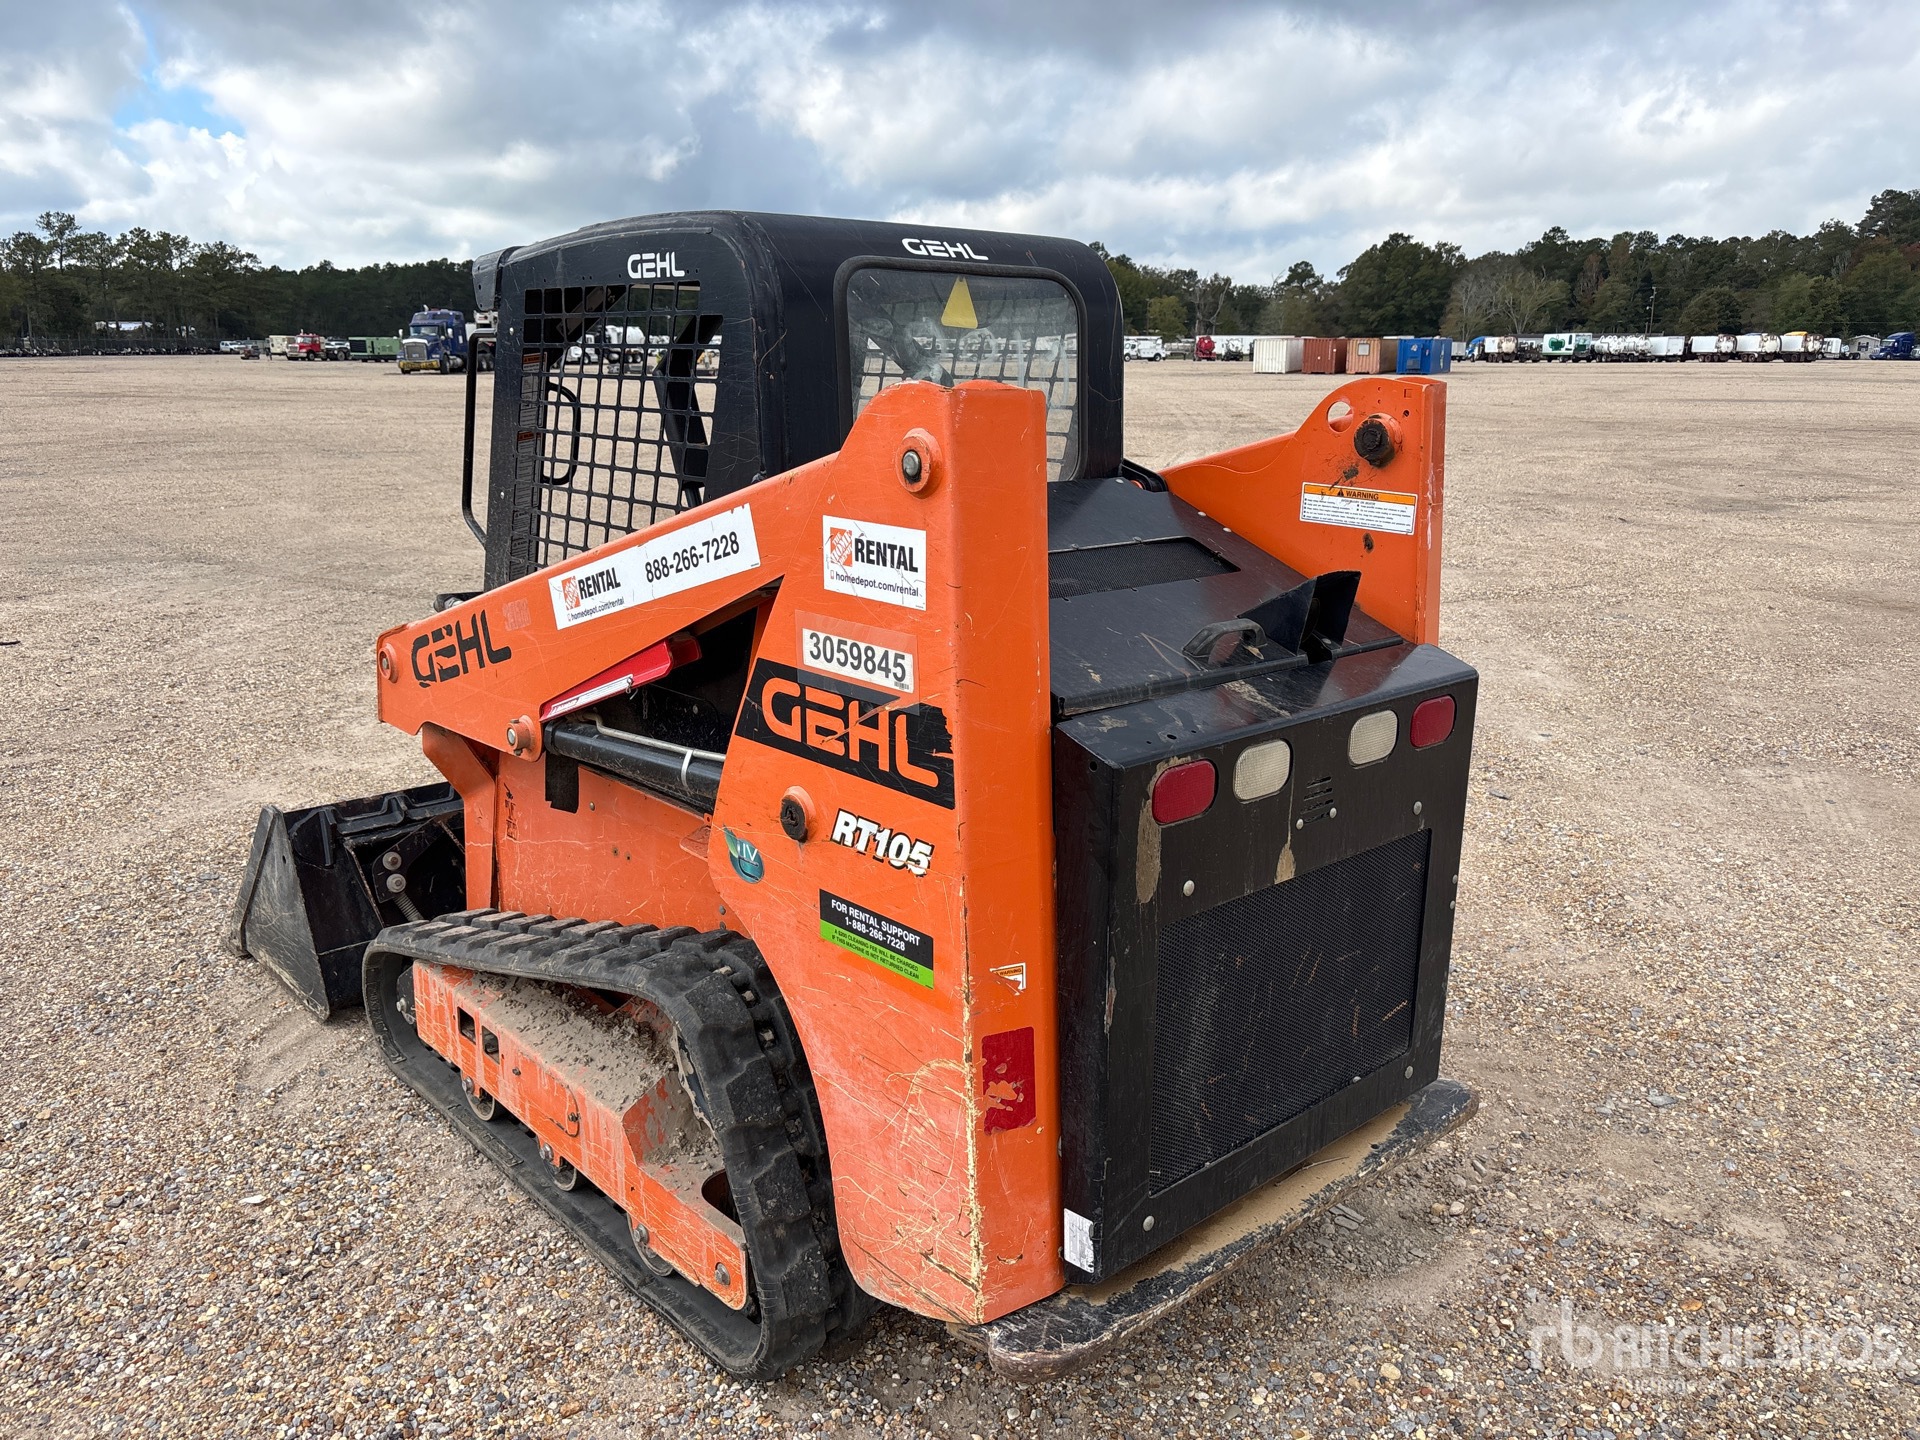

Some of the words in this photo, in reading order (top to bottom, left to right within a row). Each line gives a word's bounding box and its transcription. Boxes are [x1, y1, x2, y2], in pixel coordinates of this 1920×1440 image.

[627, 251, 685, 279] GEHL
[902, 238, 989, 260] GEHL
[1346, 490, 1379, 501] WARNING
[645, 531, 740, 583] 888-266-7228
[855, 538, 918, 573] RENTAL
[578, 567, 621, 600] RENTAL
[835, 571, 919, 597] homedepot.com/rental
[411, 609, 512, 688] GEHL
[809, 632, 906, 682] 3059845
[762, 677, 939, 788] GEHL
[830, 808, 935, 877] RT105
[831, 899, 847, 914] FOR
[849, 907, 879, 928] RENTAL
[881, 921, 920, 946] SUPPORT
[845, 916, 906, 951] 1-888-266-7228
[878, 949, 889, 958] WILL
[896, 957, 919, 972] CHARGED
[904, 968, 920, 979] CLEAN
